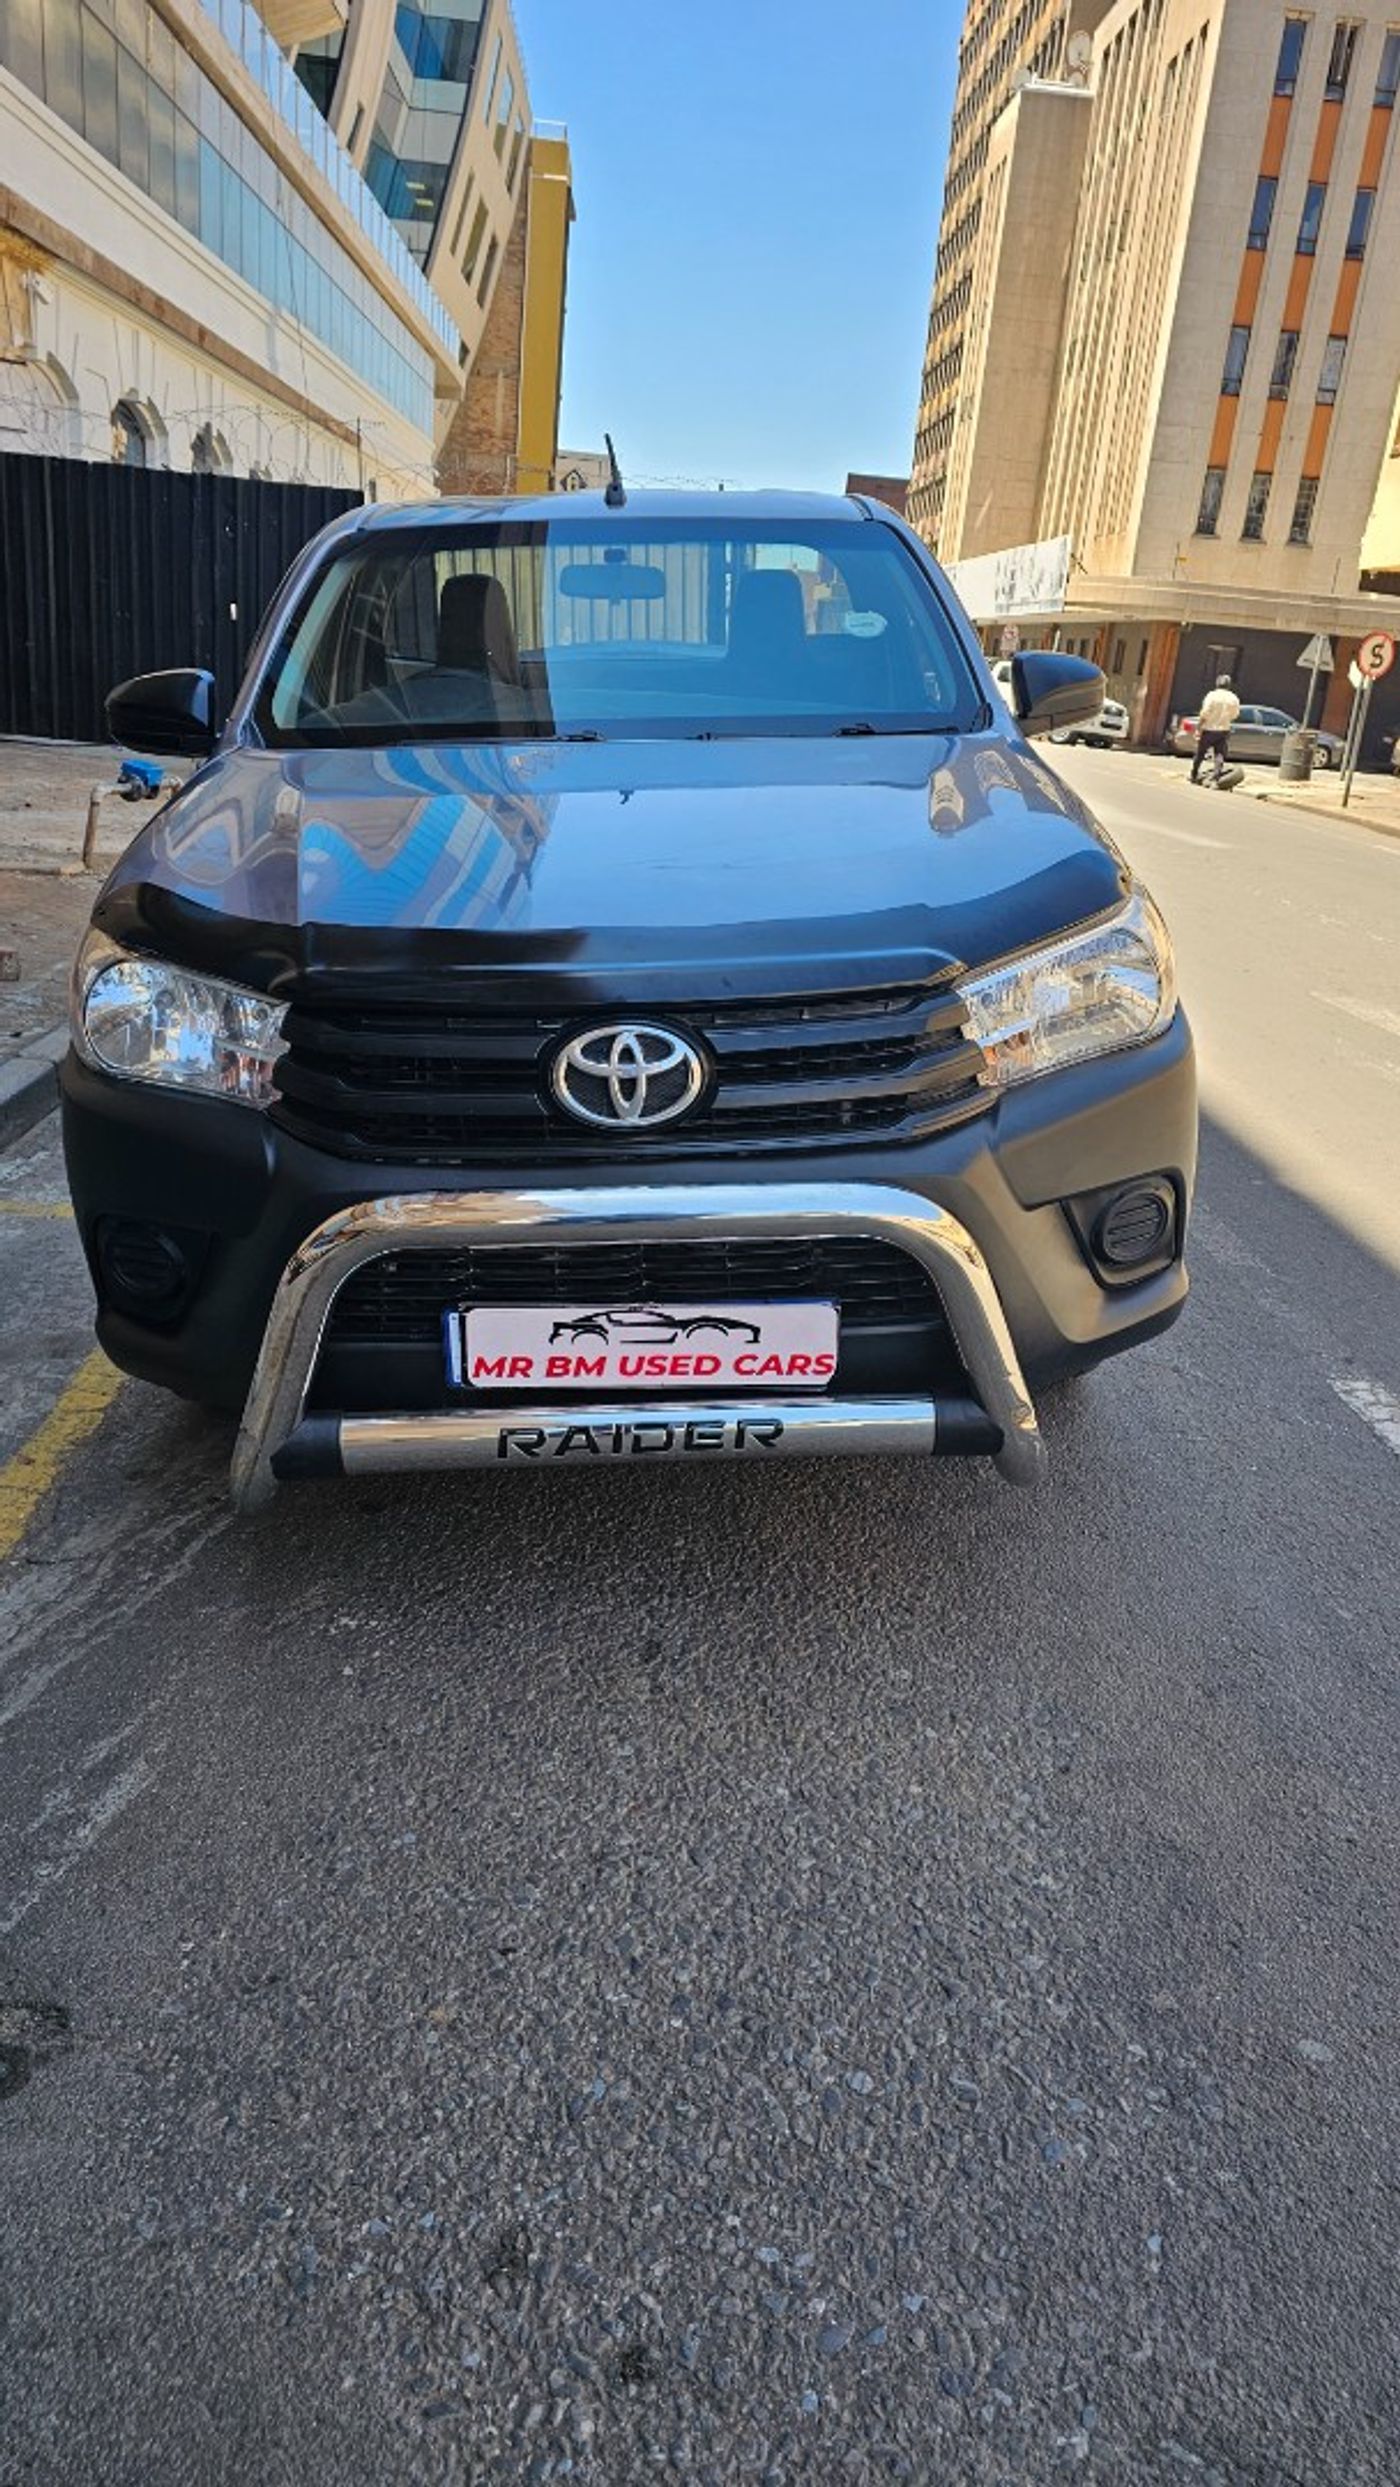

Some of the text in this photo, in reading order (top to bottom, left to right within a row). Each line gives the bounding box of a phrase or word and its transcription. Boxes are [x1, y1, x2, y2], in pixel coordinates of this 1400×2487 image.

[1370, 643, 1385, 669] S
[472, 1352, 836, 1378] MR BM USED CARS
[497, 1417, 785, 1459] RAIDER
